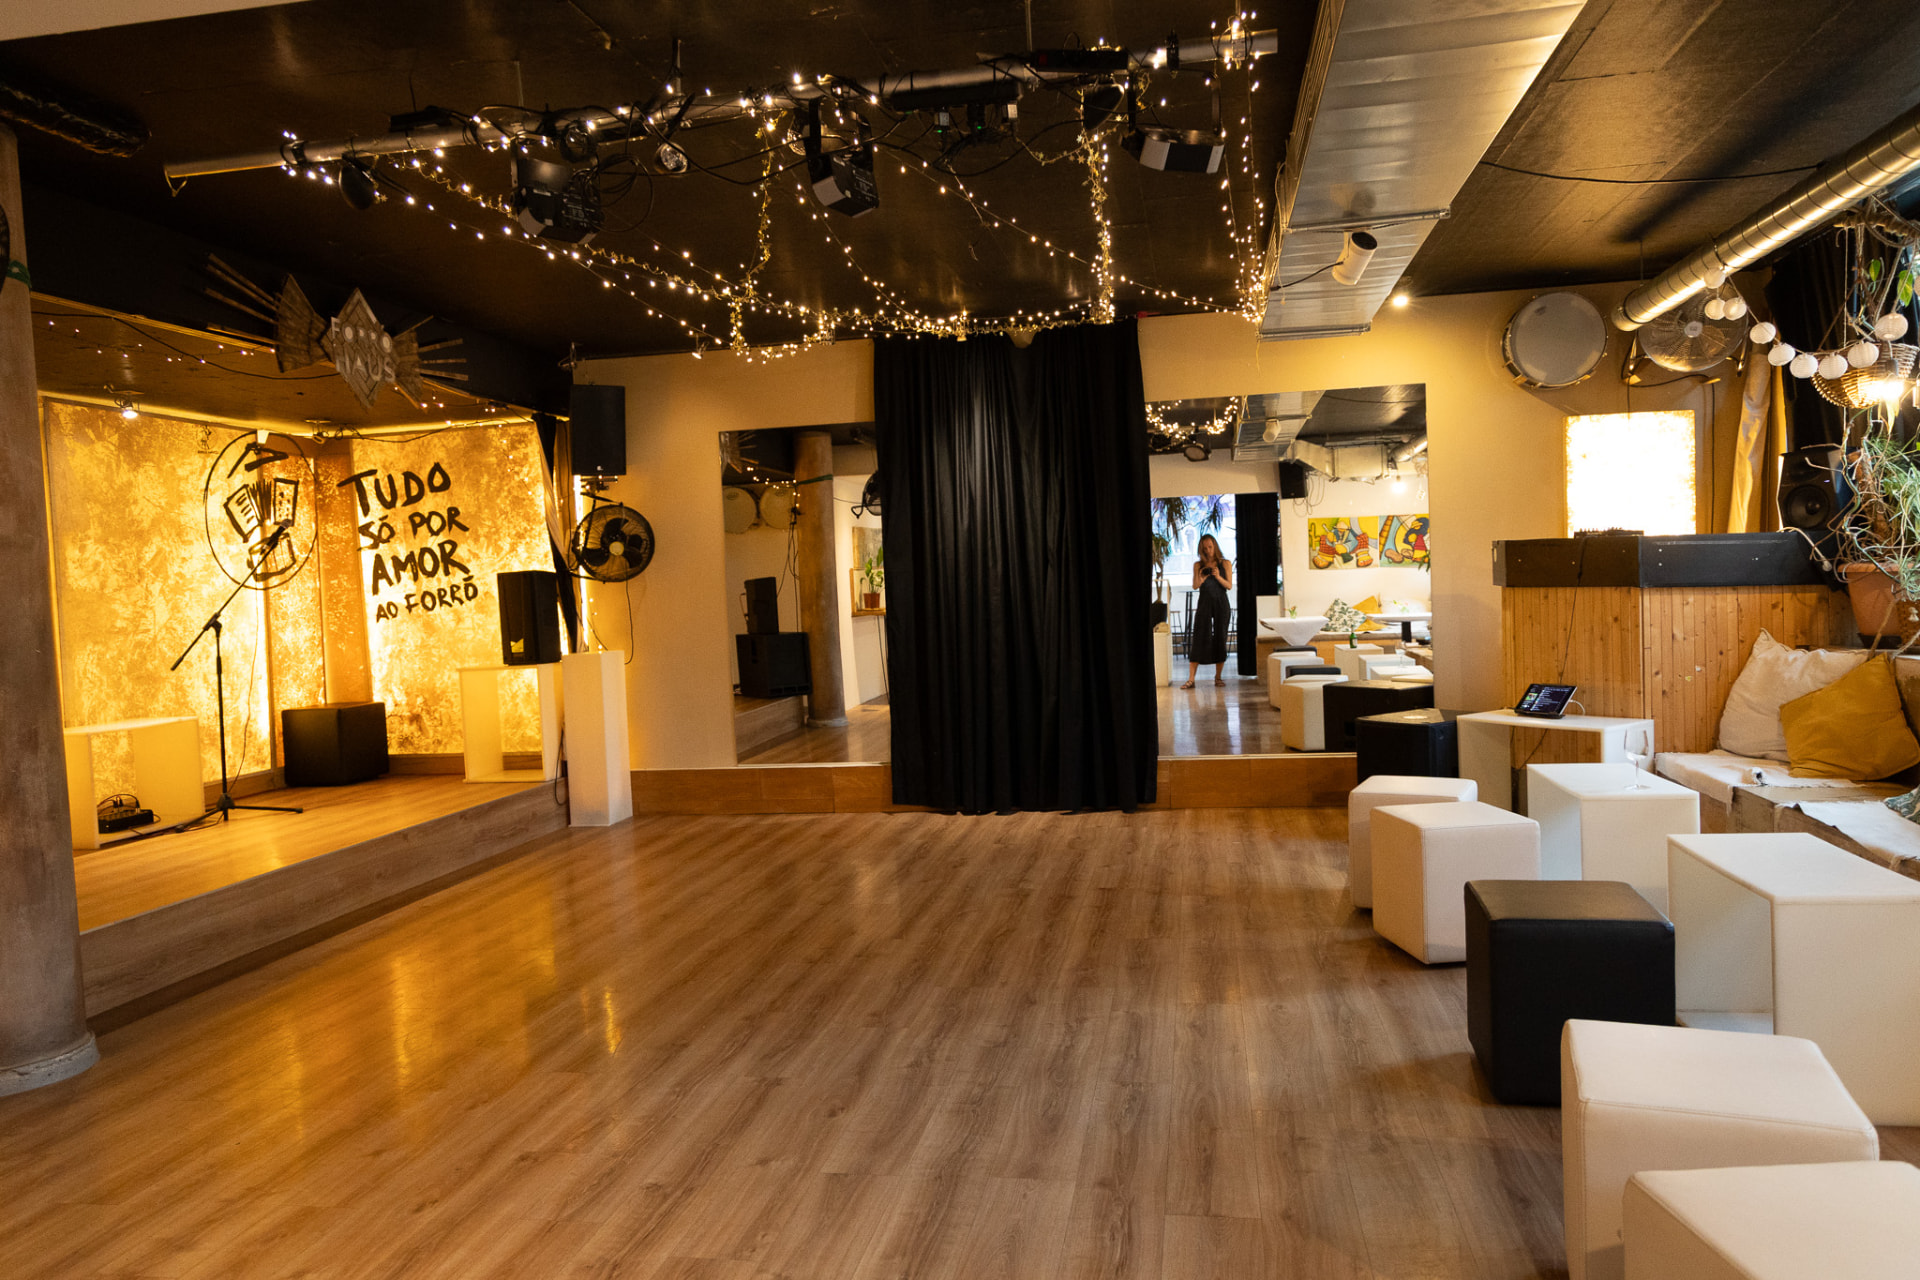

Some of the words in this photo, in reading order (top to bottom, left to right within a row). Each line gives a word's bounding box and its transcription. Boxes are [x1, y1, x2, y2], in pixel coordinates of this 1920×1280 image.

[337, 462, 451, 517] TUDO
[357, 515, 396, 551] SÓ
[408, 506, 470, 539] POR
[372, 539, 471, 596] AMOR
[376, 601, 399, 623] AO
[404, 575, 479, 614] FORRÓ
